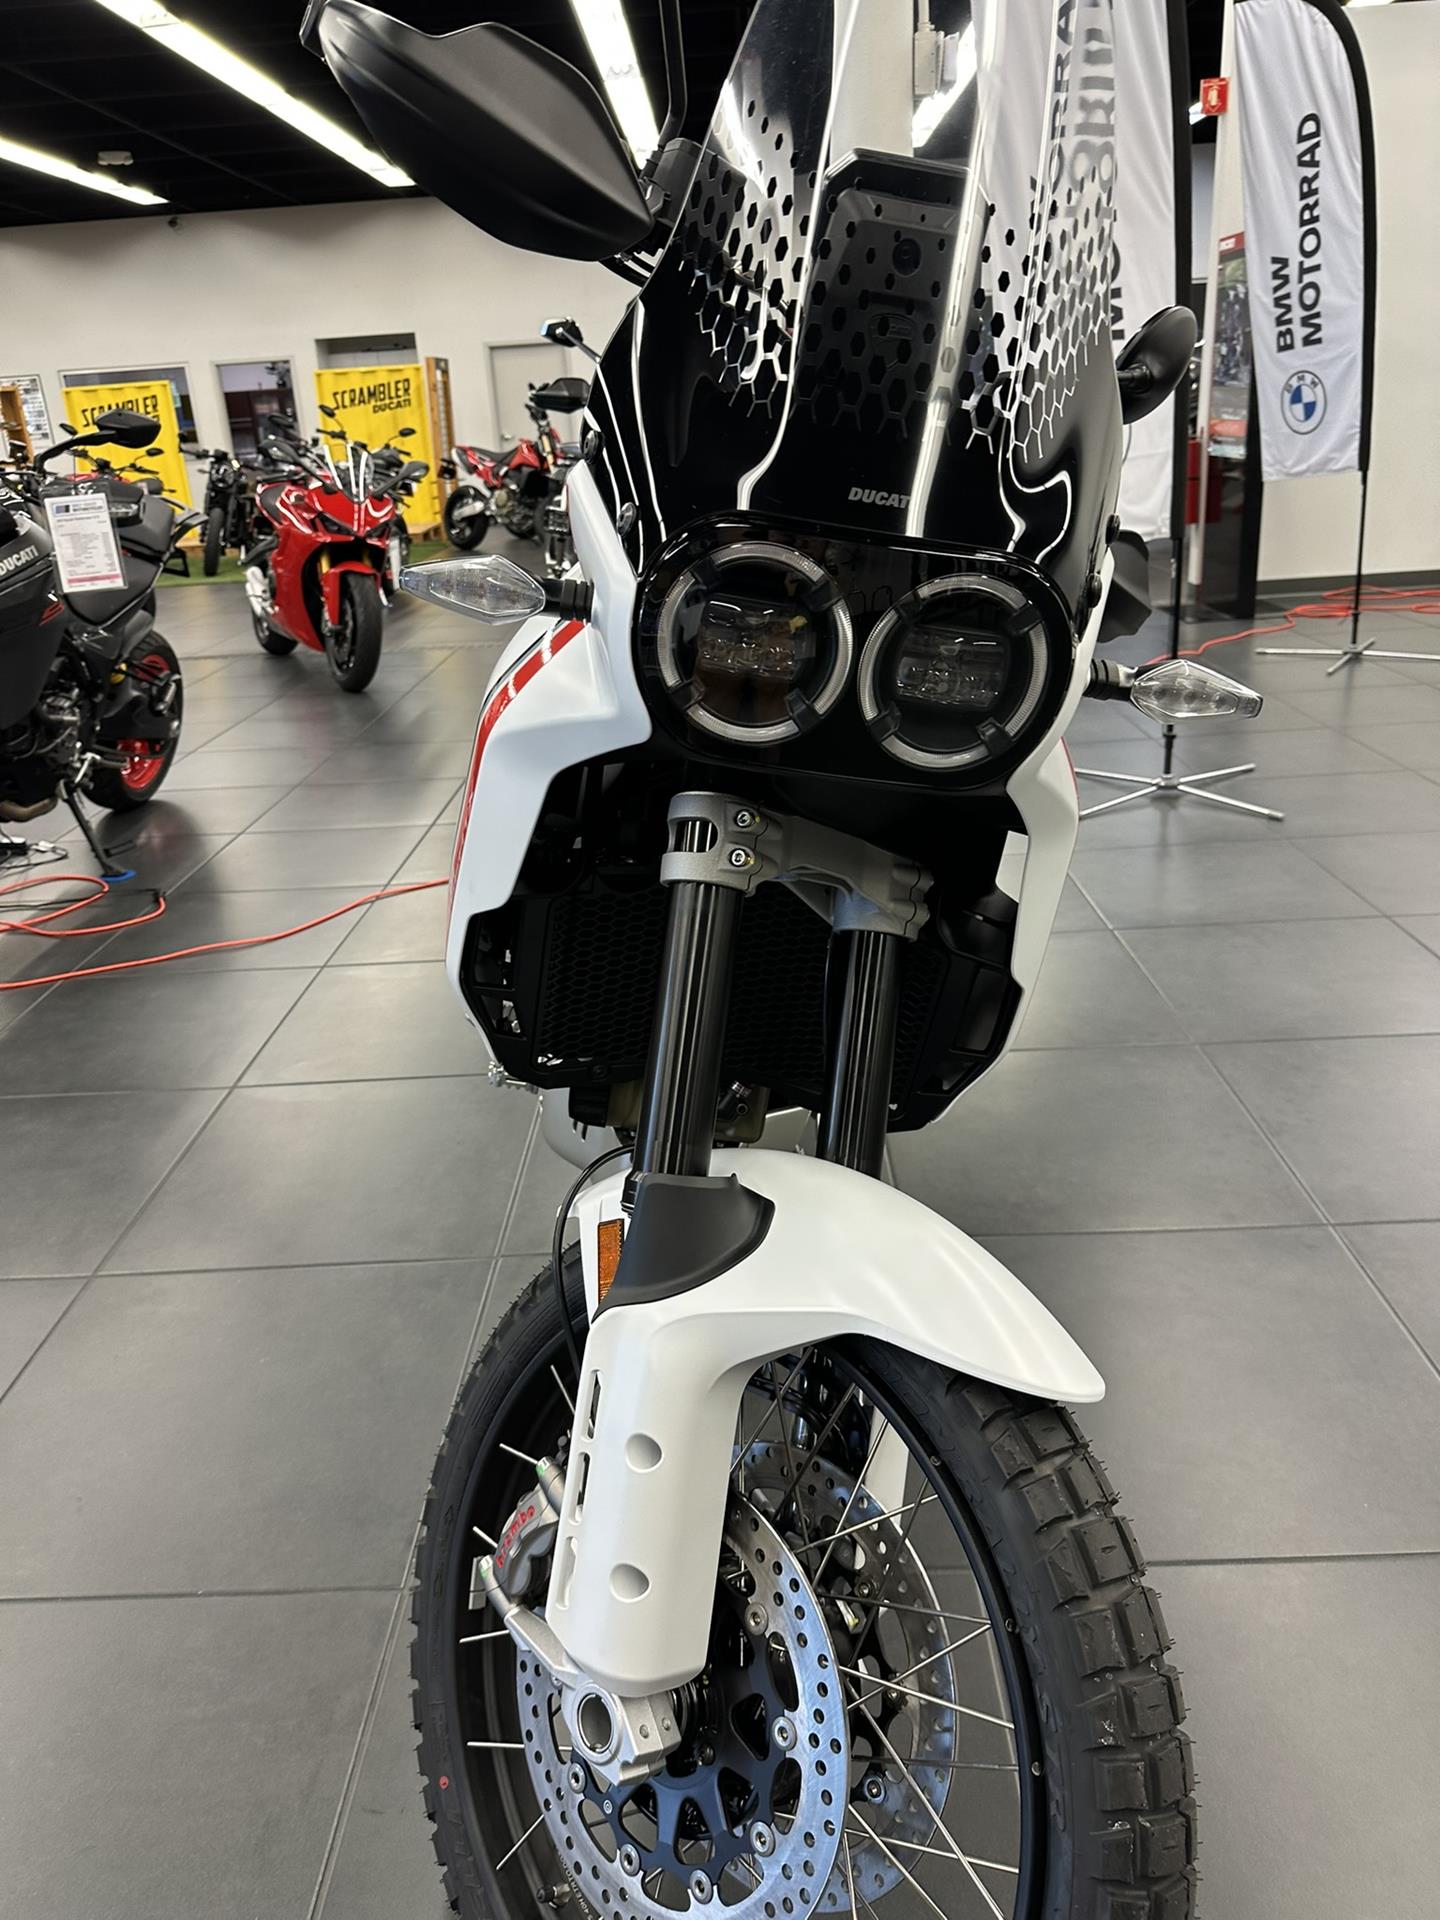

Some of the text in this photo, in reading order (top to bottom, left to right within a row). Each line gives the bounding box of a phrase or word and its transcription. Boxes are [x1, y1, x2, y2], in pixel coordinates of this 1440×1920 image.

[1297, 113, 1322, 347] MOTORRAD
[1271, 256, 1295, 353] BMW
[332, 378, 411, 411] SCRAMBLER
[372, 398, 412, 414] DUCATI
[848, 487, 912, 508] DUCAT
[495, 1505, 535, 1569] brembo
